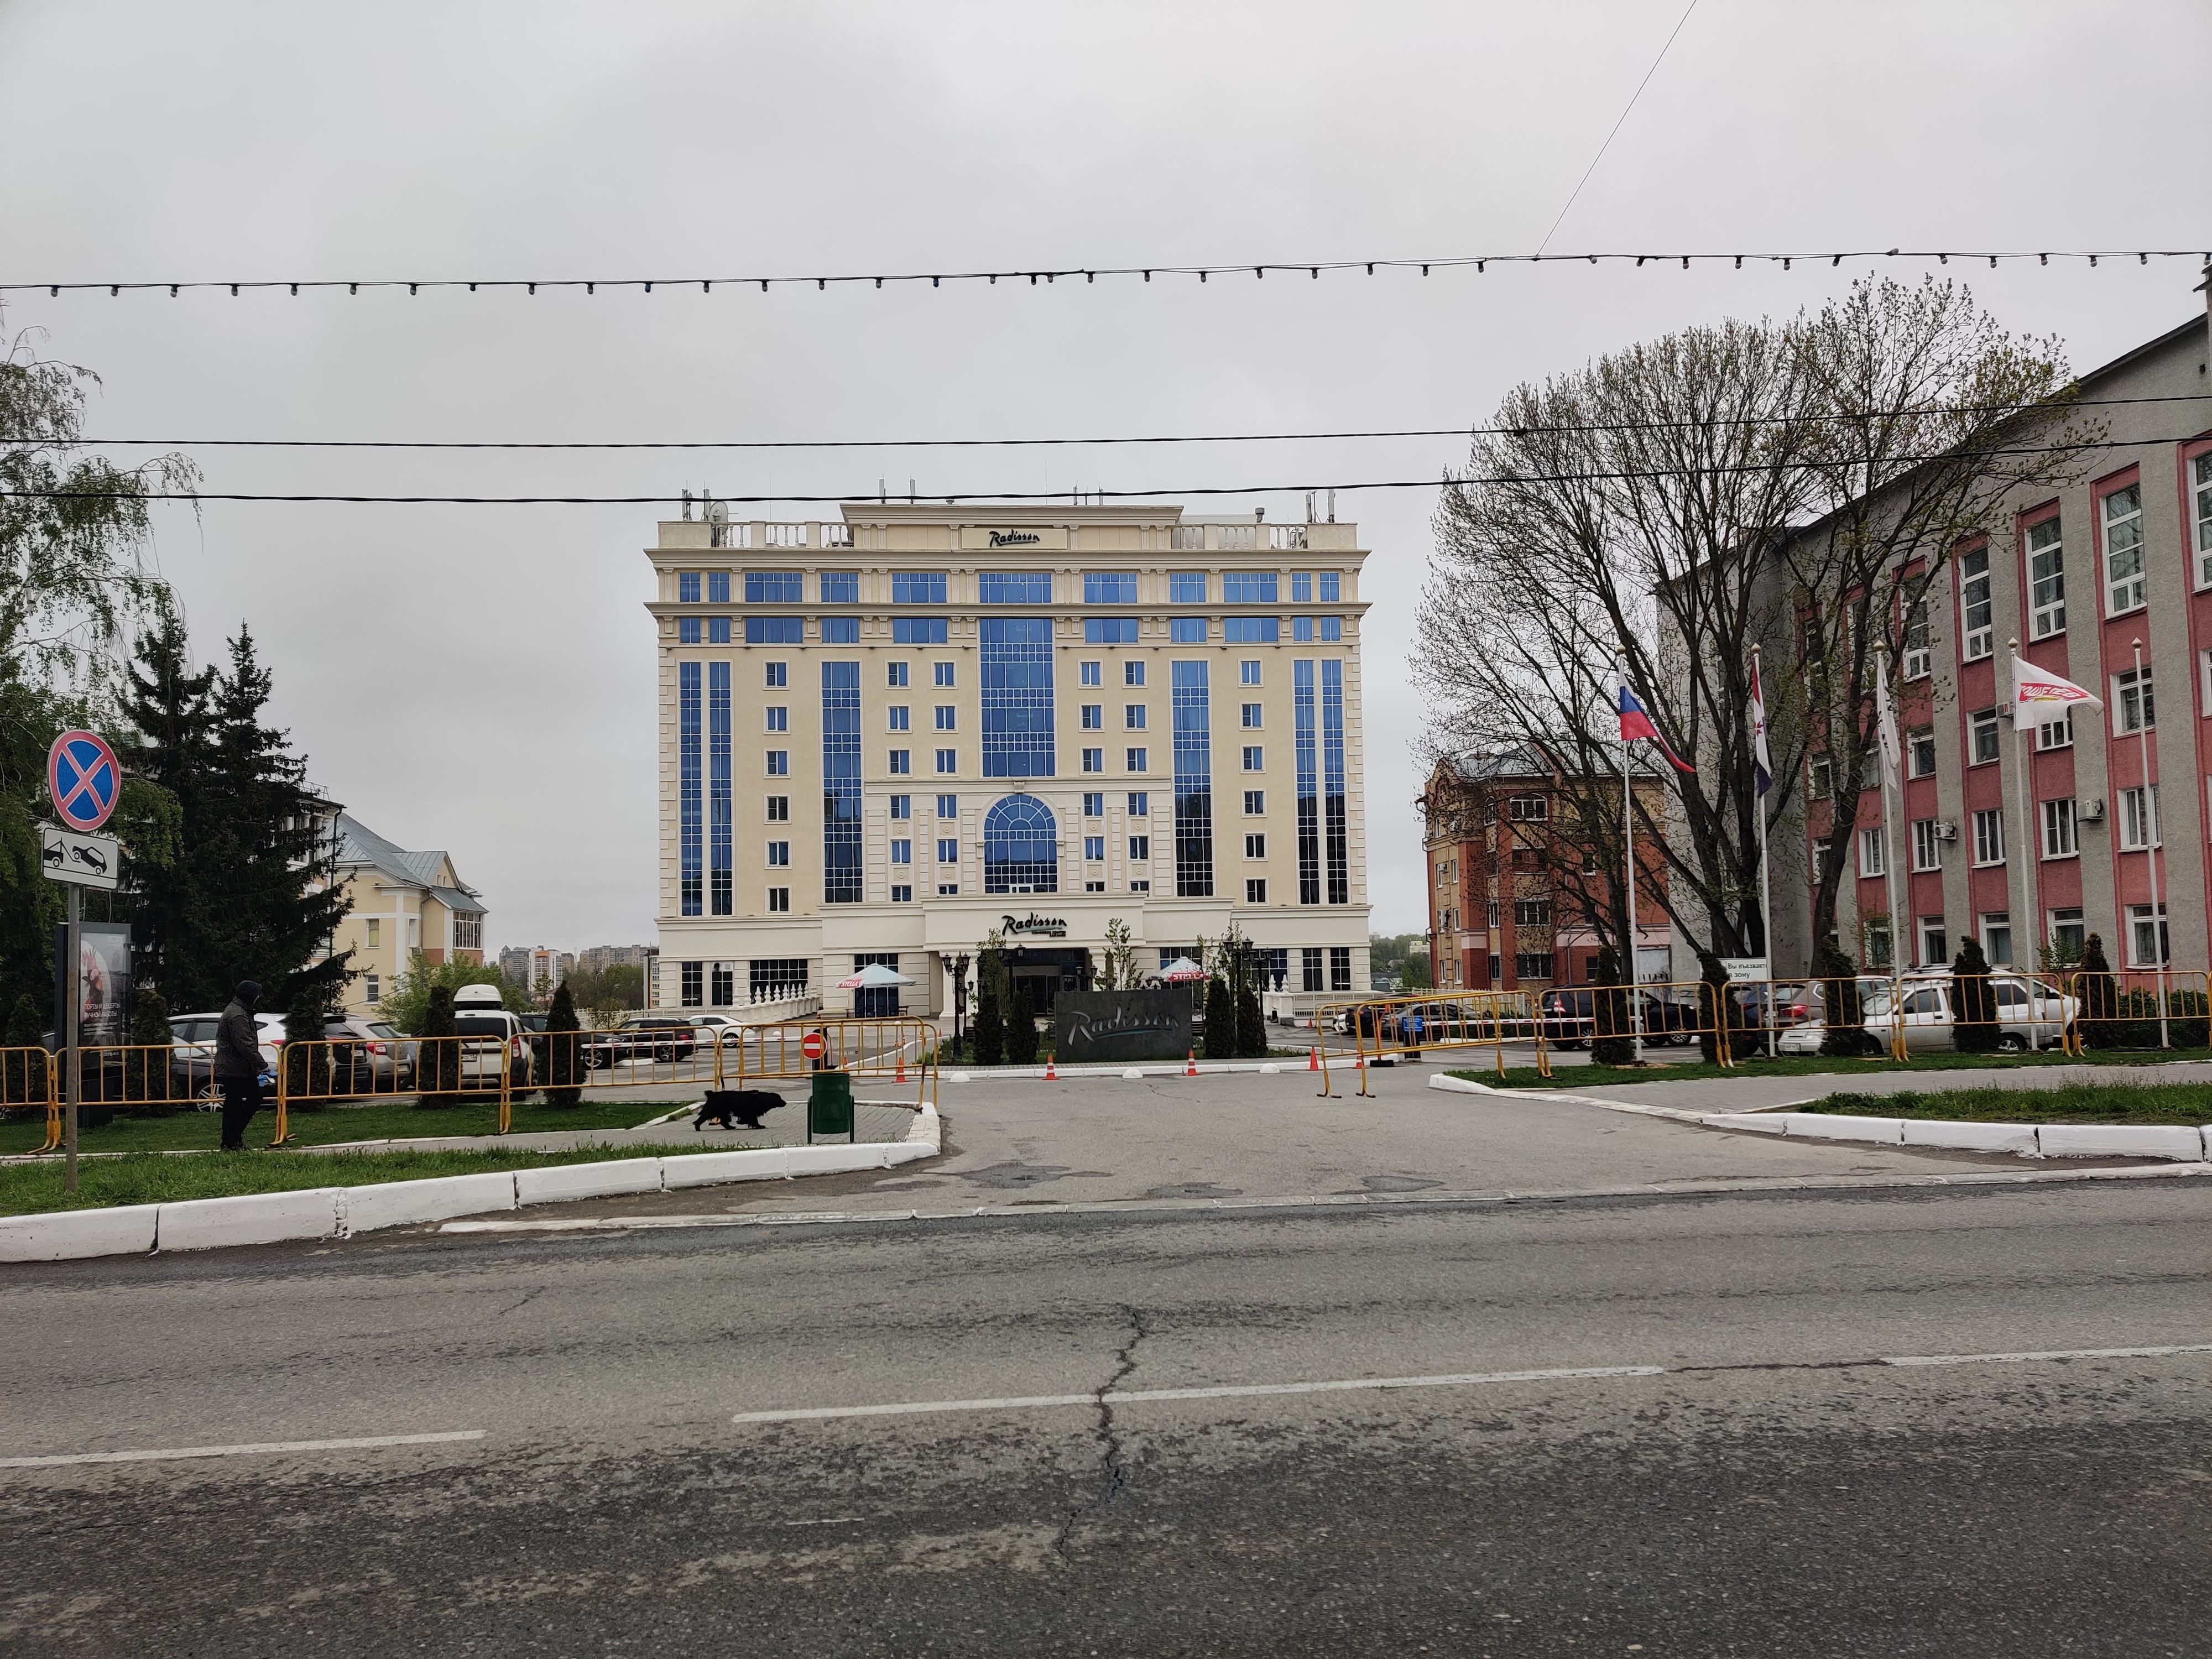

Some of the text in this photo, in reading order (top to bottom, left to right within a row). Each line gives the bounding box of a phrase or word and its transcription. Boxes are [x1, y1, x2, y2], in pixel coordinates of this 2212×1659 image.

[989, 528, 1040, 547] Radisson
[1001, 911, 1067, 936] Radisson
[1068, 1001, 1180, 1046] Radisson
